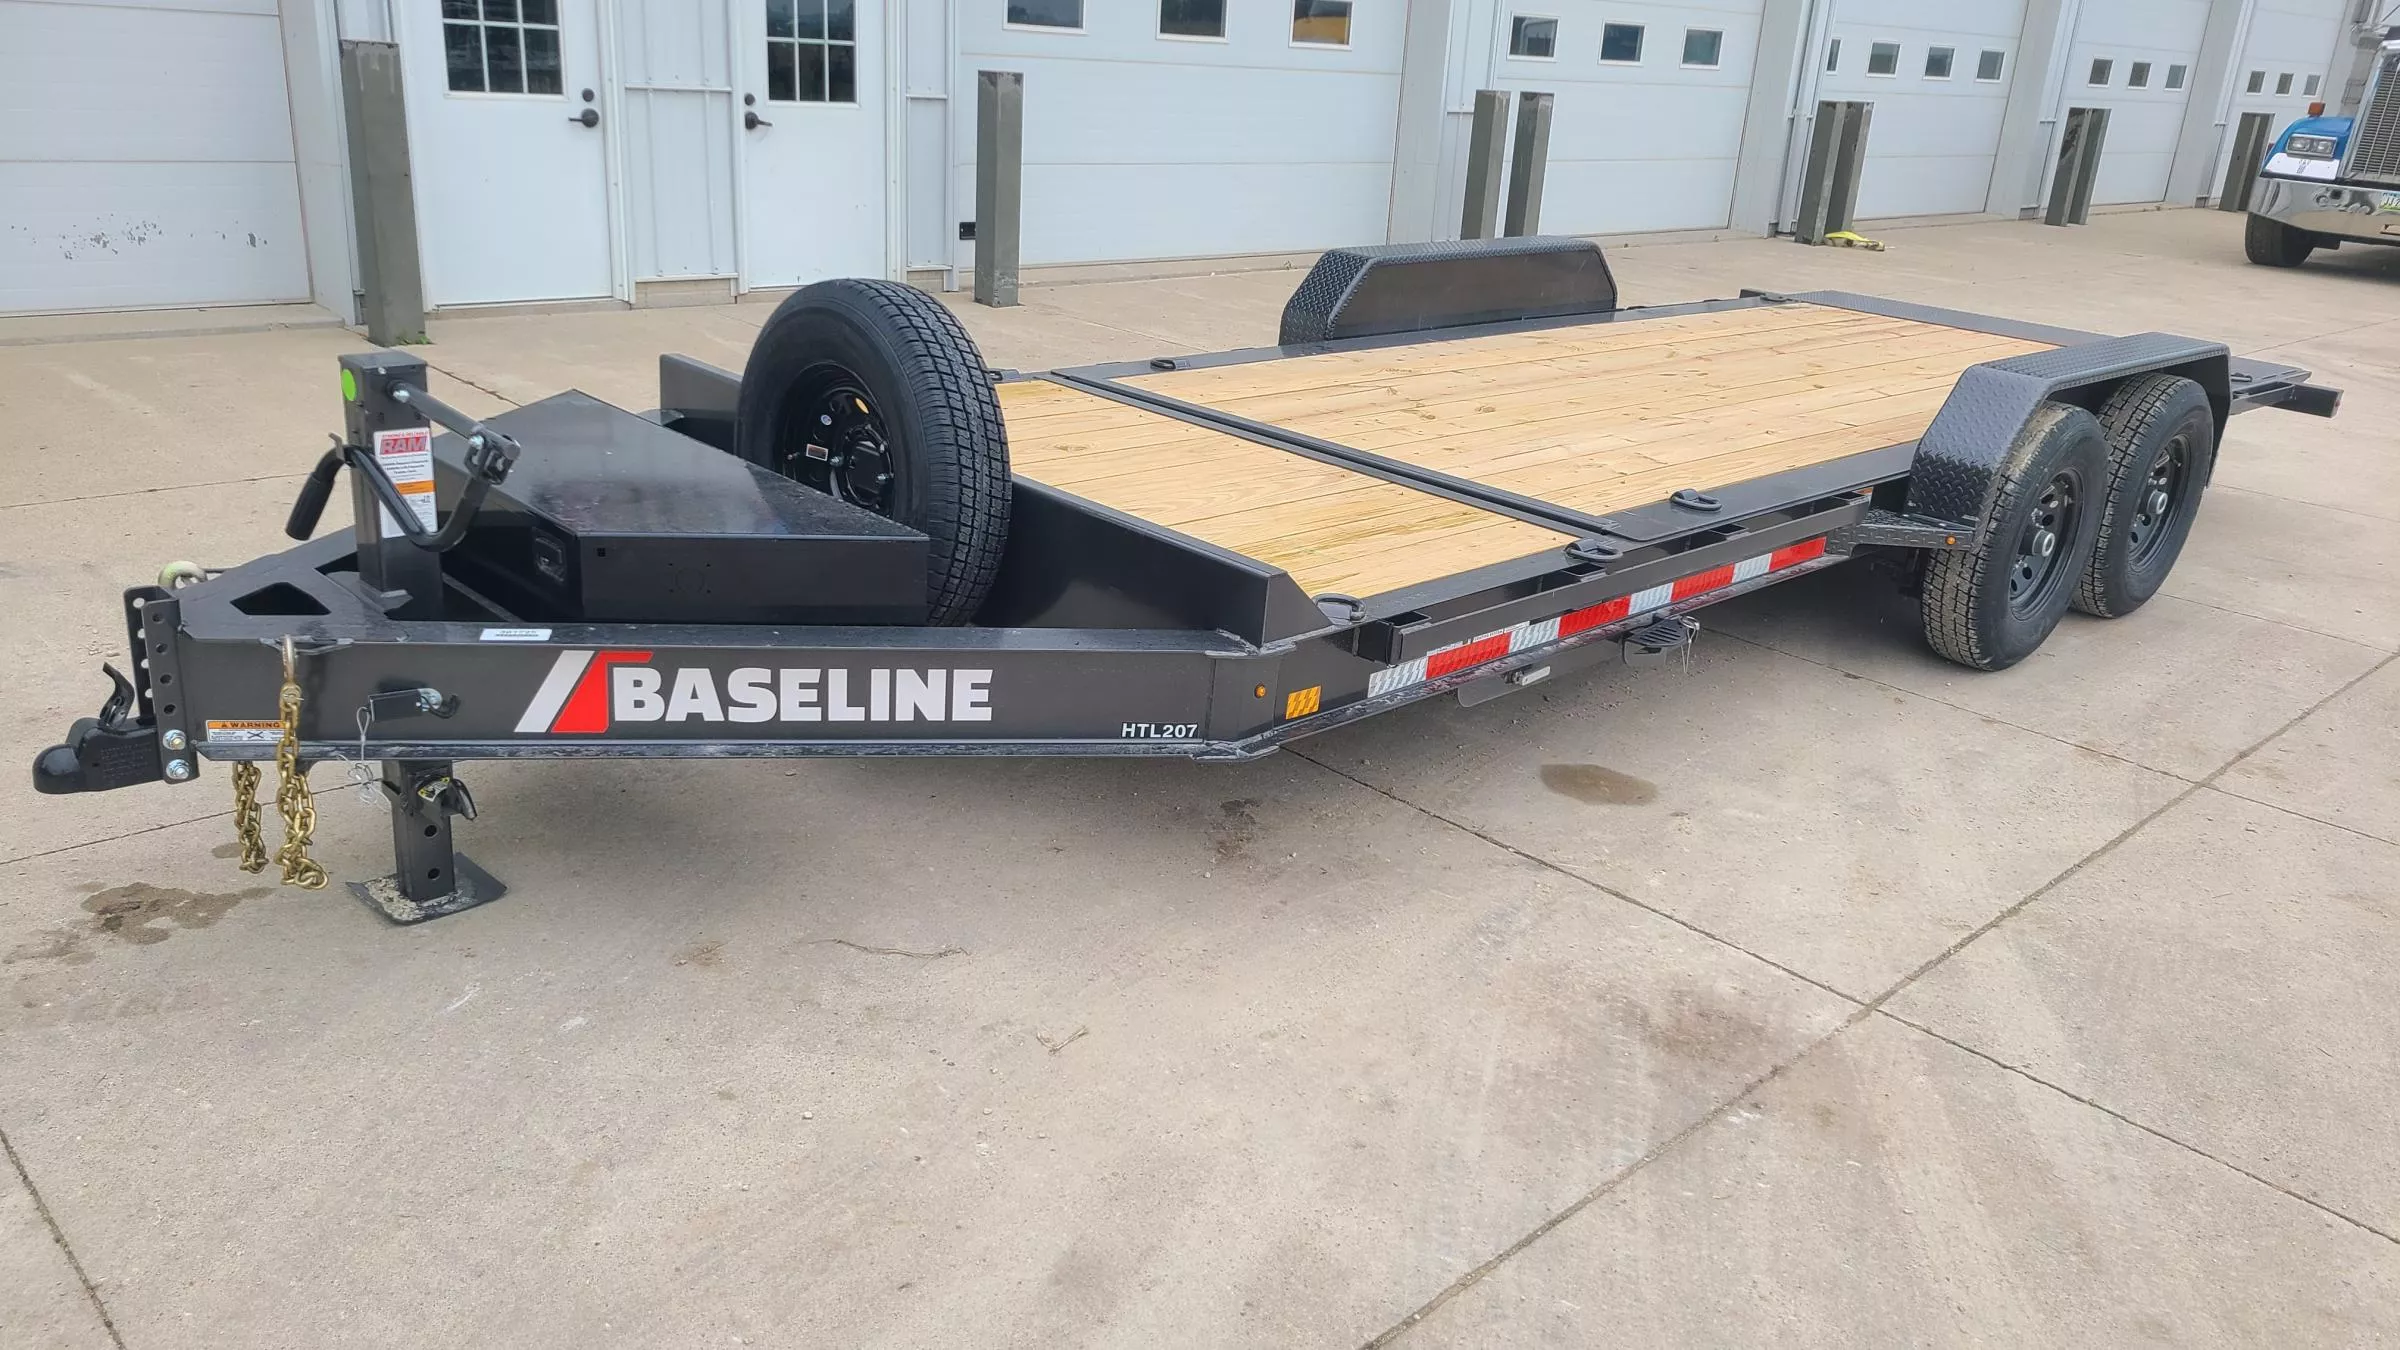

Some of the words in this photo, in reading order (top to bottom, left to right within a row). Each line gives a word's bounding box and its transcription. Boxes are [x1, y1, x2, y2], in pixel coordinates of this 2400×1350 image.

[381, 437, 427, 454] RAM
[613, 667, 994, 723] BASELINE
[231, 721, 281, 729] WARNING
[1121, 723, 1198, 738] HTL207
